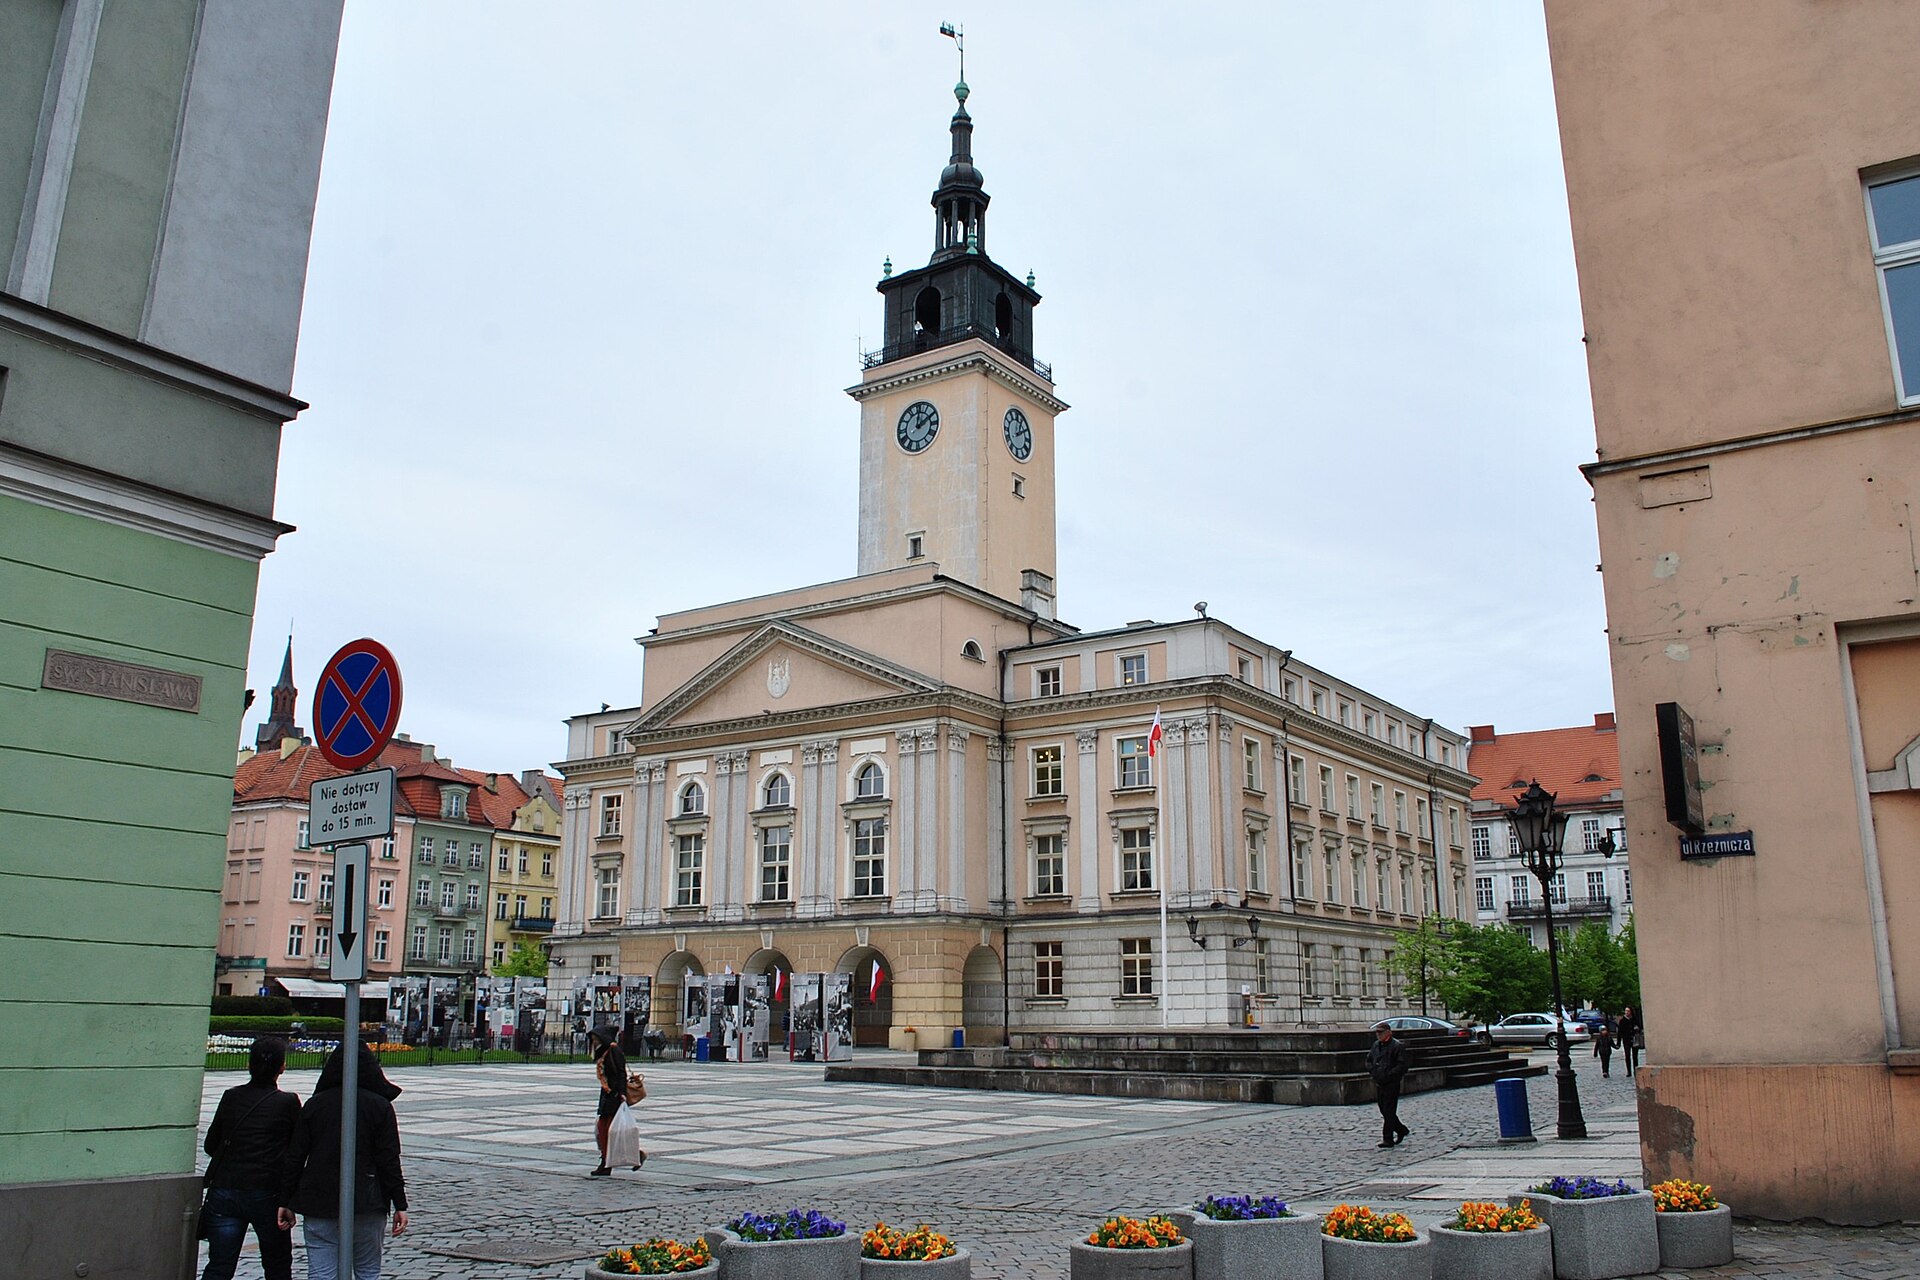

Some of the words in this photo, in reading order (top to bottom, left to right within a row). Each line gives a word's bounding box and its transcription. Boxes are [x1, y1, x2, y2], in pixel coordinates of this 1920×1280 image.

[321, 786, 338, 800] Nie
[342, 781, 380, 797] dotyczy
[331, 800, 367, 814] dostaw
[321, 819, 334, 832] do
[339, 816, 349, 829] 15
[354, 813, 376, 827] min.
